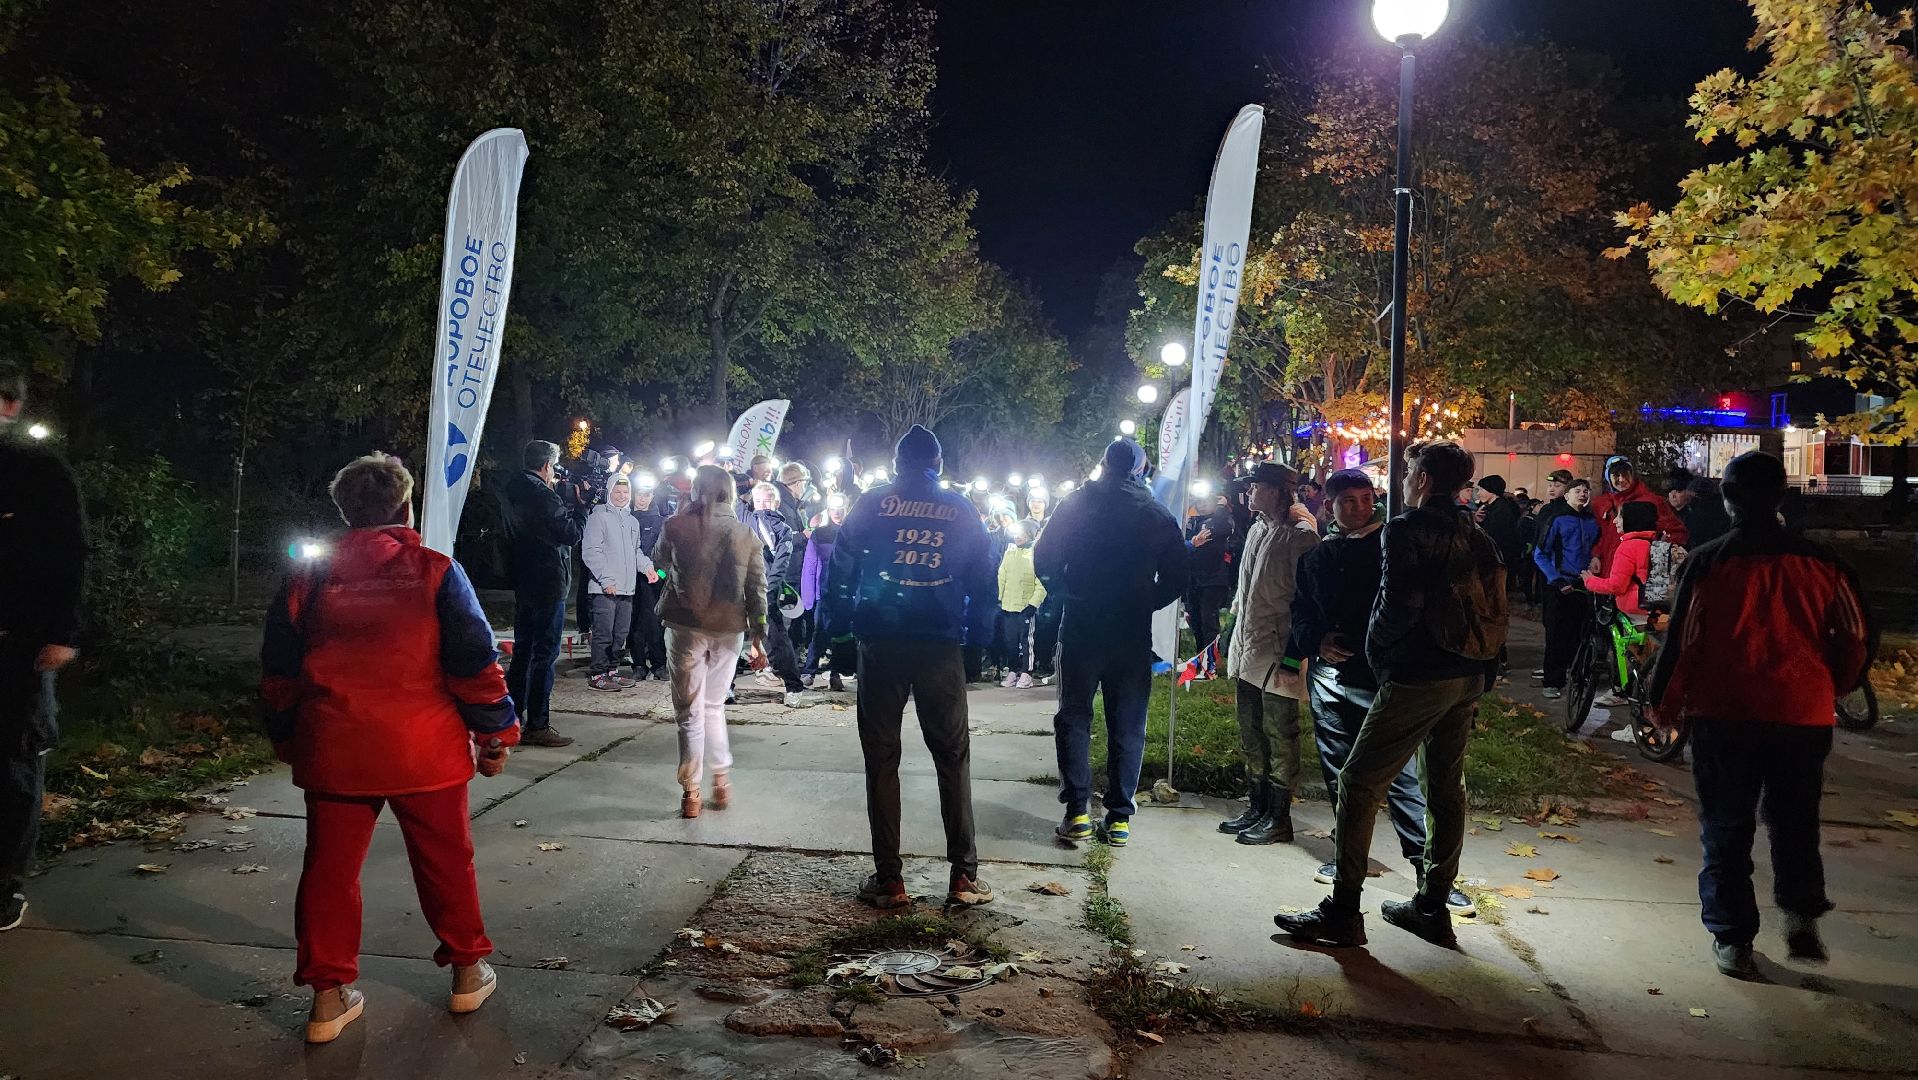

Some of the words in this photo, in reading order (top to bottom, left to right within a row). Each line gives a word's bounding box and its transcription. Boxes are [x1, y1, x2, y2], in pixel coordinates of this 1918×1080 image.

[457, 241, 507, 409] ОТЕЧЕСТВО
[894, 528, 944, 548] 1923
[893, 550, 942, 569] 2013
